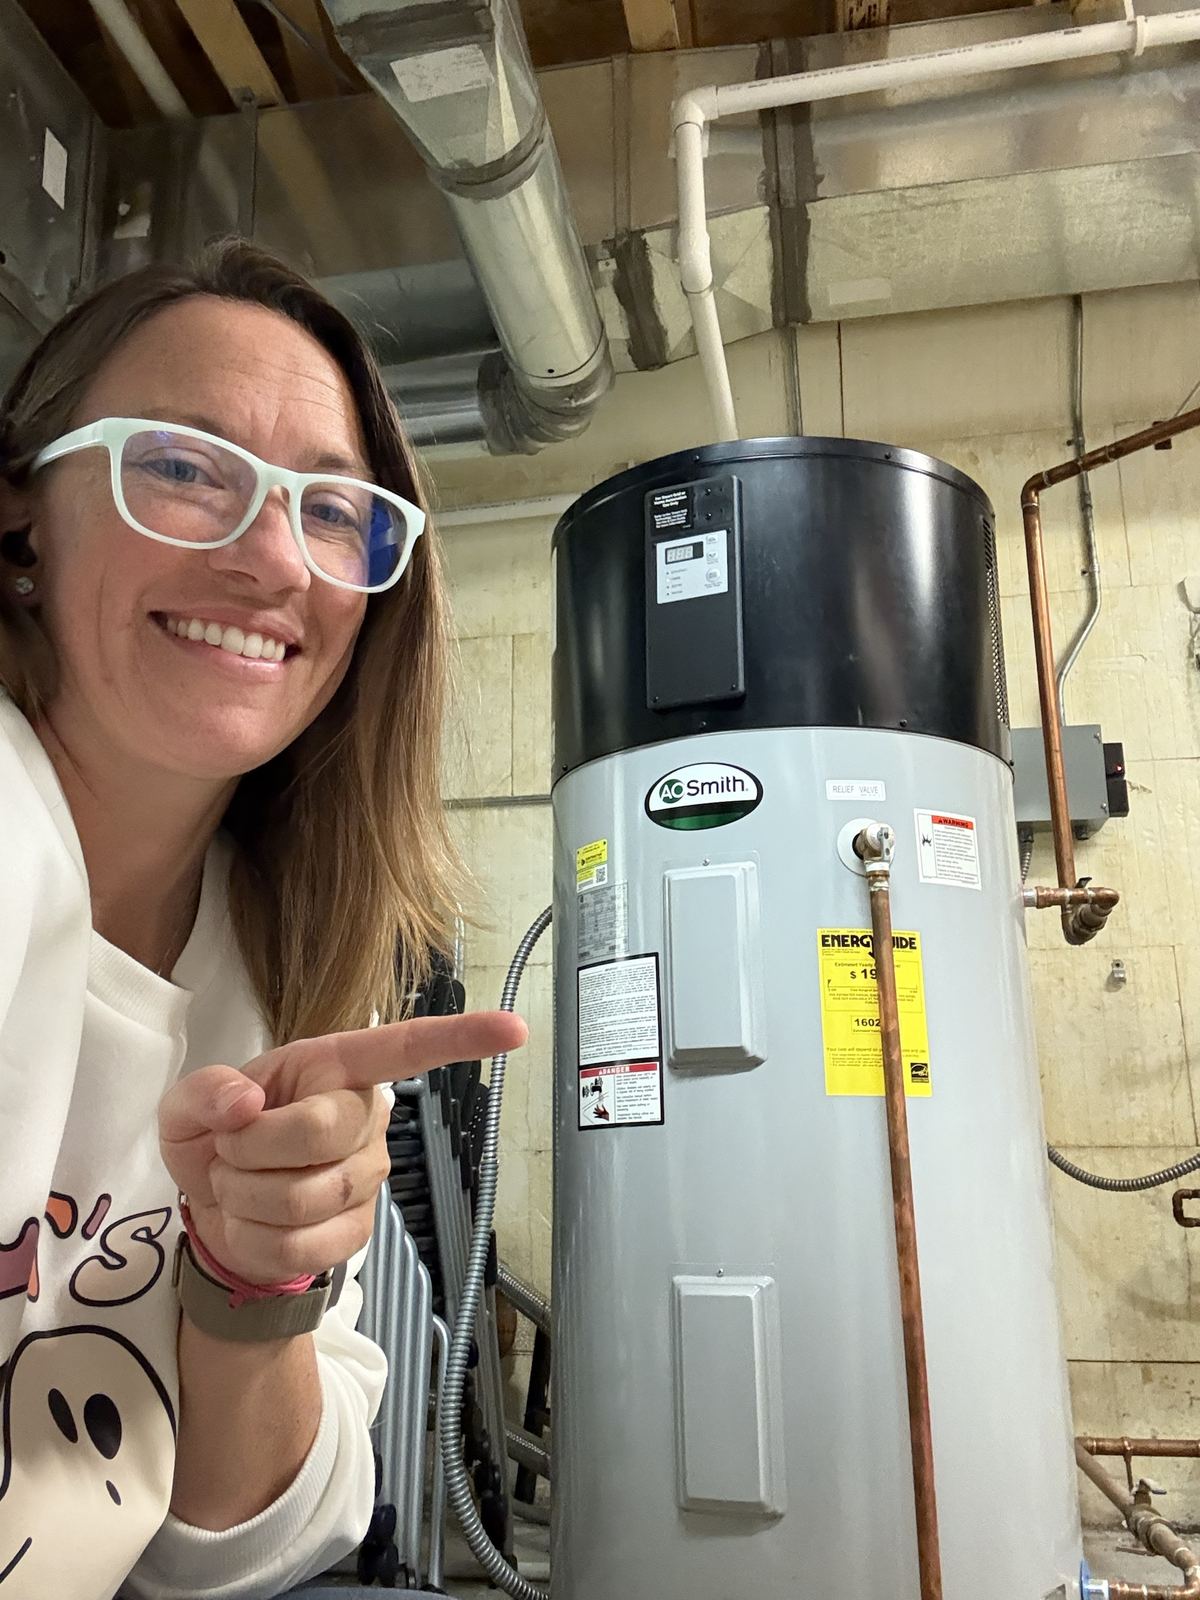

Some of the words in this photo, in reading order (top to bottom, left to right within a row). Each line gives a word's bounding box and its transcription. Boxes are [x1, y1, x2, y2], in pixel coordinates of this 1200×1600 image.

[687, 775, 745, 796] Smith
[832, 785, 855, 794] RELIEF
[860, 785, 879, 794] VALVE
[942, 818, 969, 828] WARNING
[821, 934, 917, 950] ENERGYUIDE
[850, 970, 857, 980] $
[861, 968, 878, 980] 19
[602, 1066, 630, 1076] DANGER
